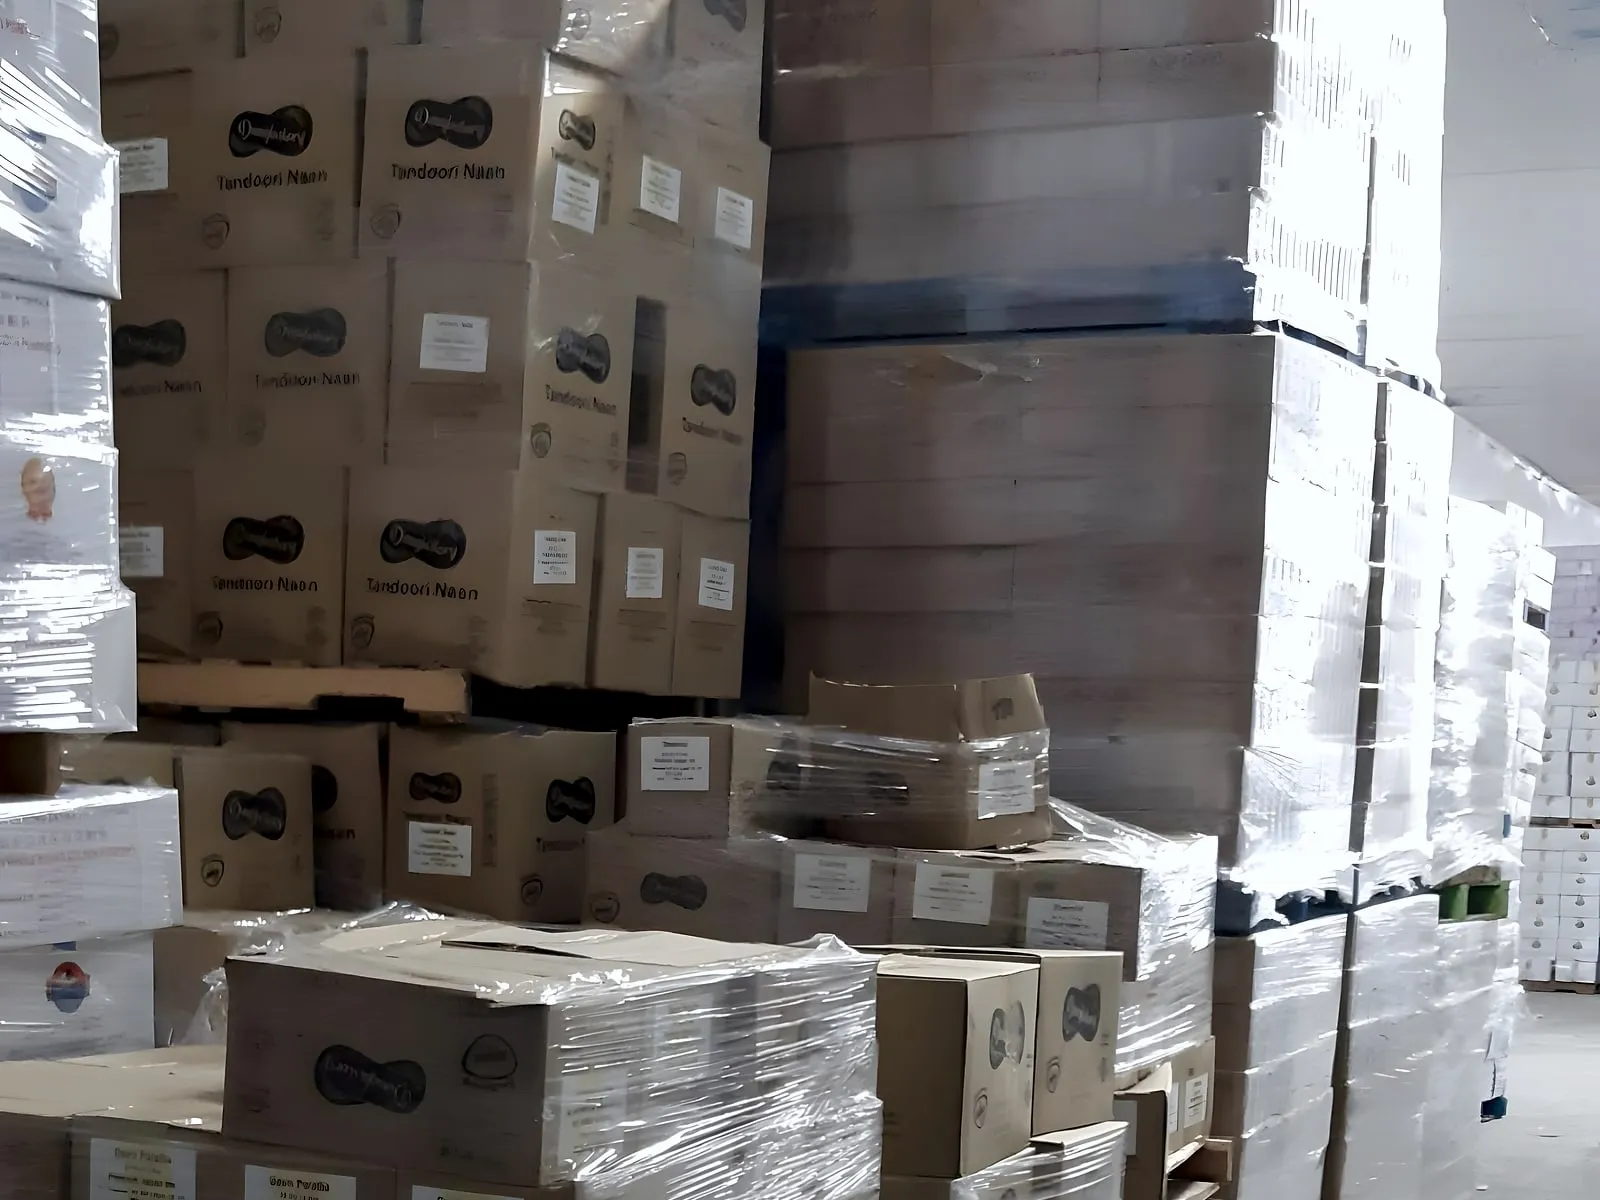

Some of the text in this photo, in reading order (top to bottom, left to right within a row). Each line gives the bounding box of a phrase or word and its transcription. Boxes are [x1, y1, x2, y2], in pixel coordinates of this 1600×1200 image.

[392, 163, 459, 180] Tandoori
[216, 172, 283, 191] Tandoori
[367, 577, 479, 601] Tandoori Naan
